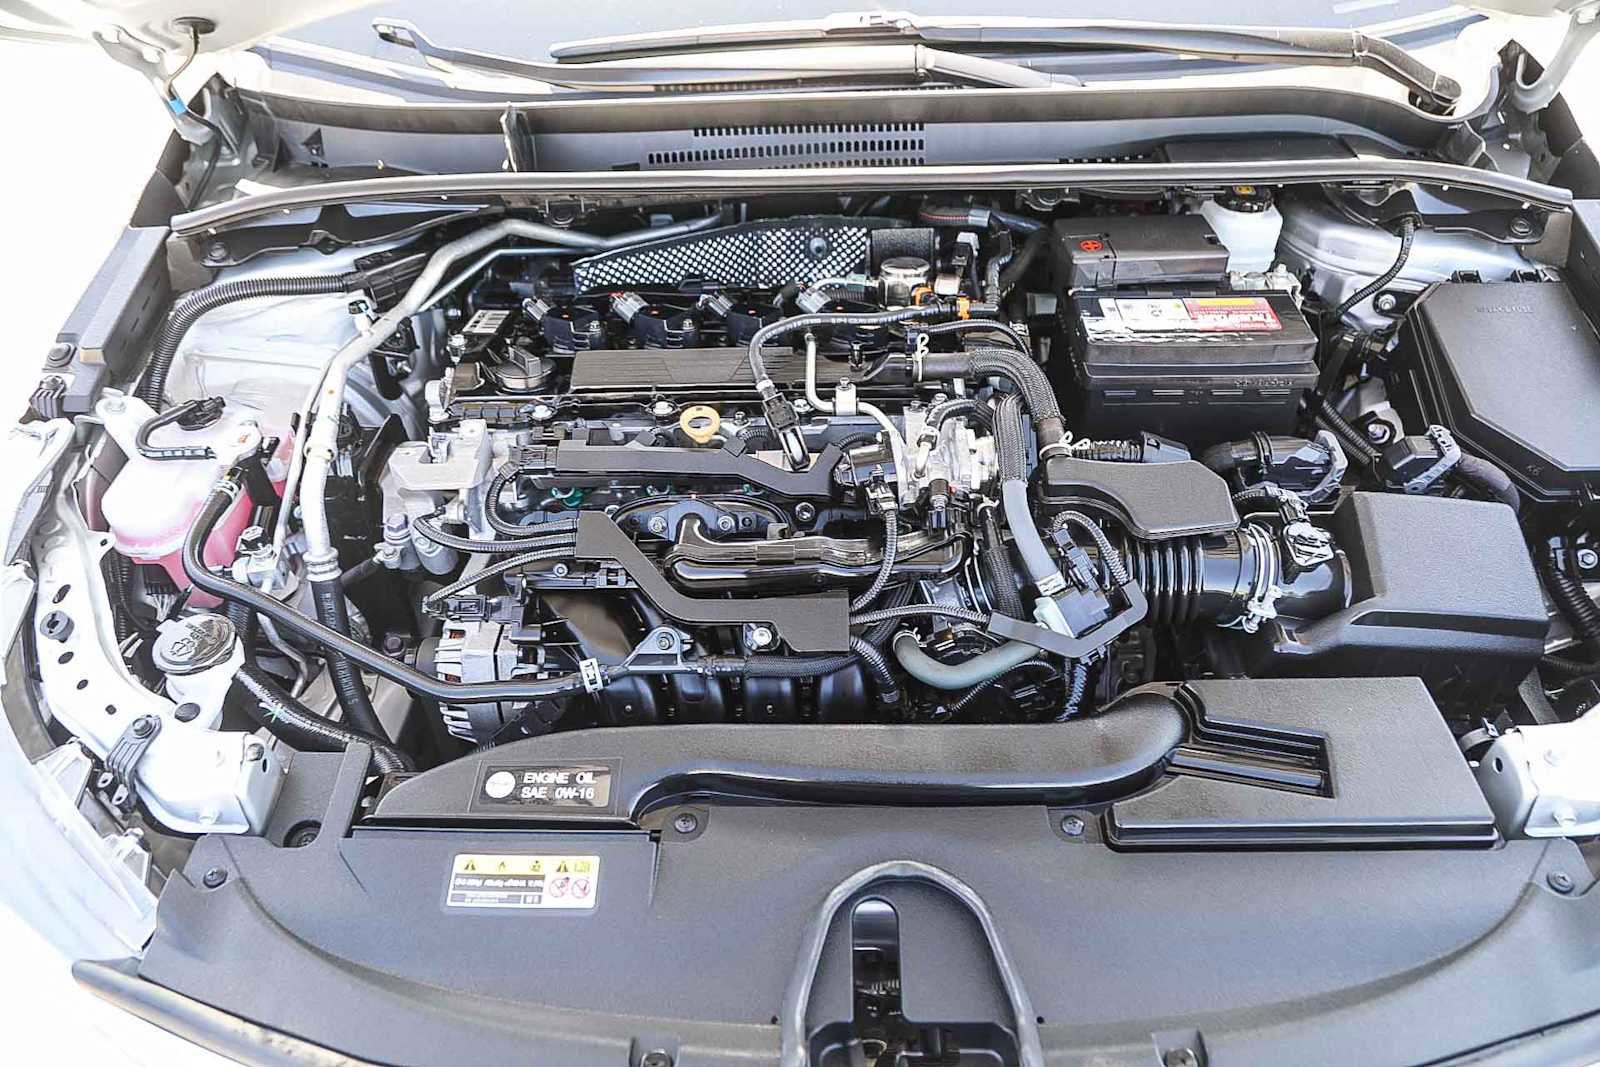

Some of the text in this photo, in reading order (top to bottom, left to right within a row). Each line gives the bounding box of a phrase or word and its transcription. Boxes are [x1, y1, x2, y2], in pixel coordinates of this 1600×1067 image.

[523, 771, 597, 784] ENGINE OIL
[520, 786, 595, 799] SAE 0W-16
